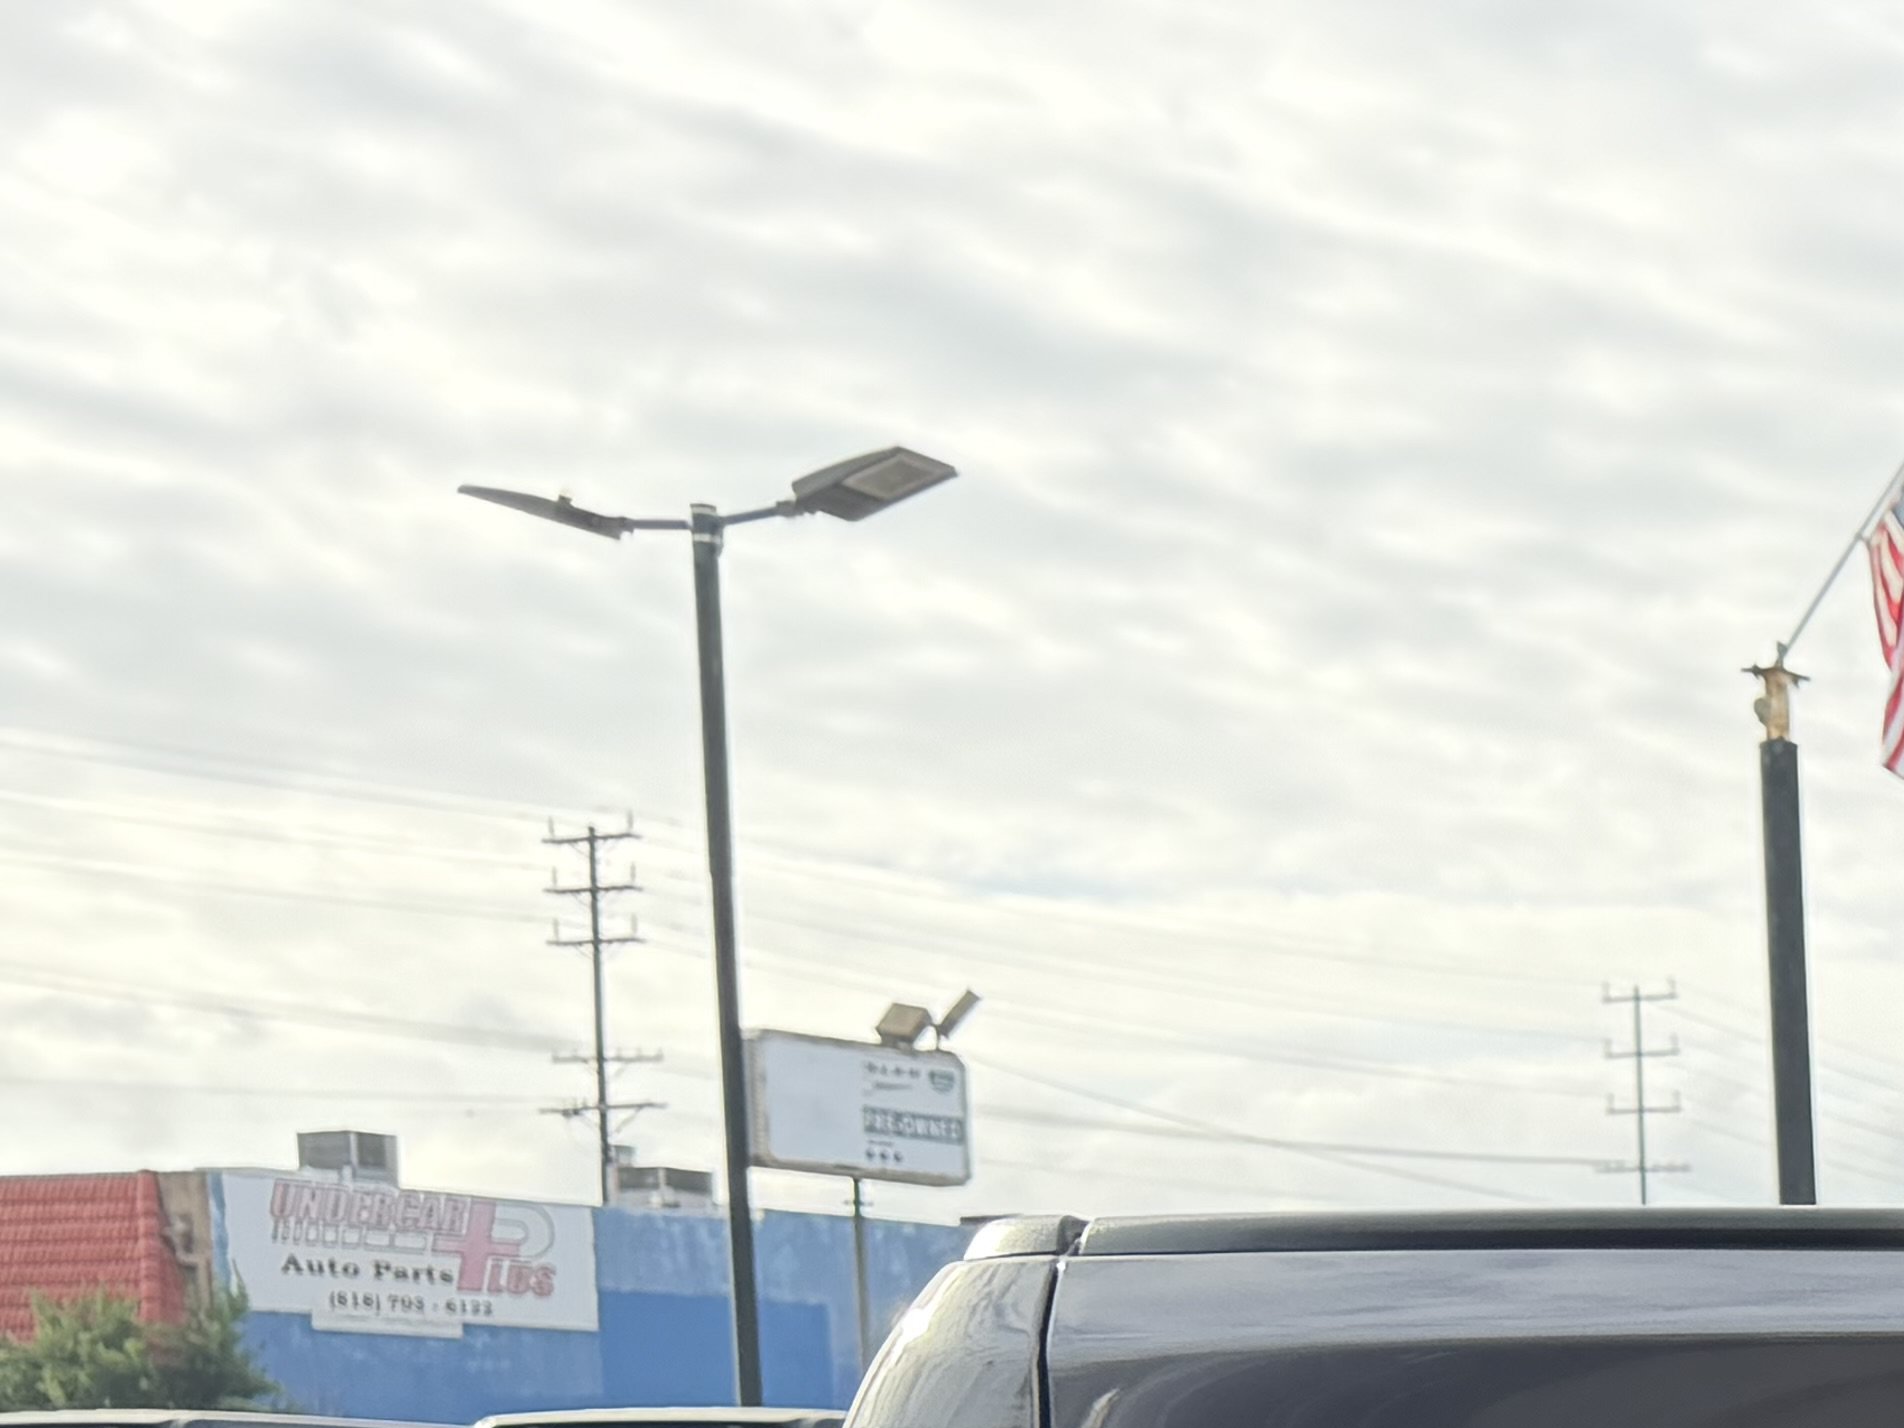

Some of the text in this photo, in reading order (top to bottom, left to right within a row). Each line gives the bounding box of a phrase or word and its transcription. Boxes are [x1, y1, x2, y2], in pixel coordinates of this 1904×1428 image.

[270, 1178, 470, 1235] UNDERCAR
[281, 1253, 455, 1285] Auto Parts
